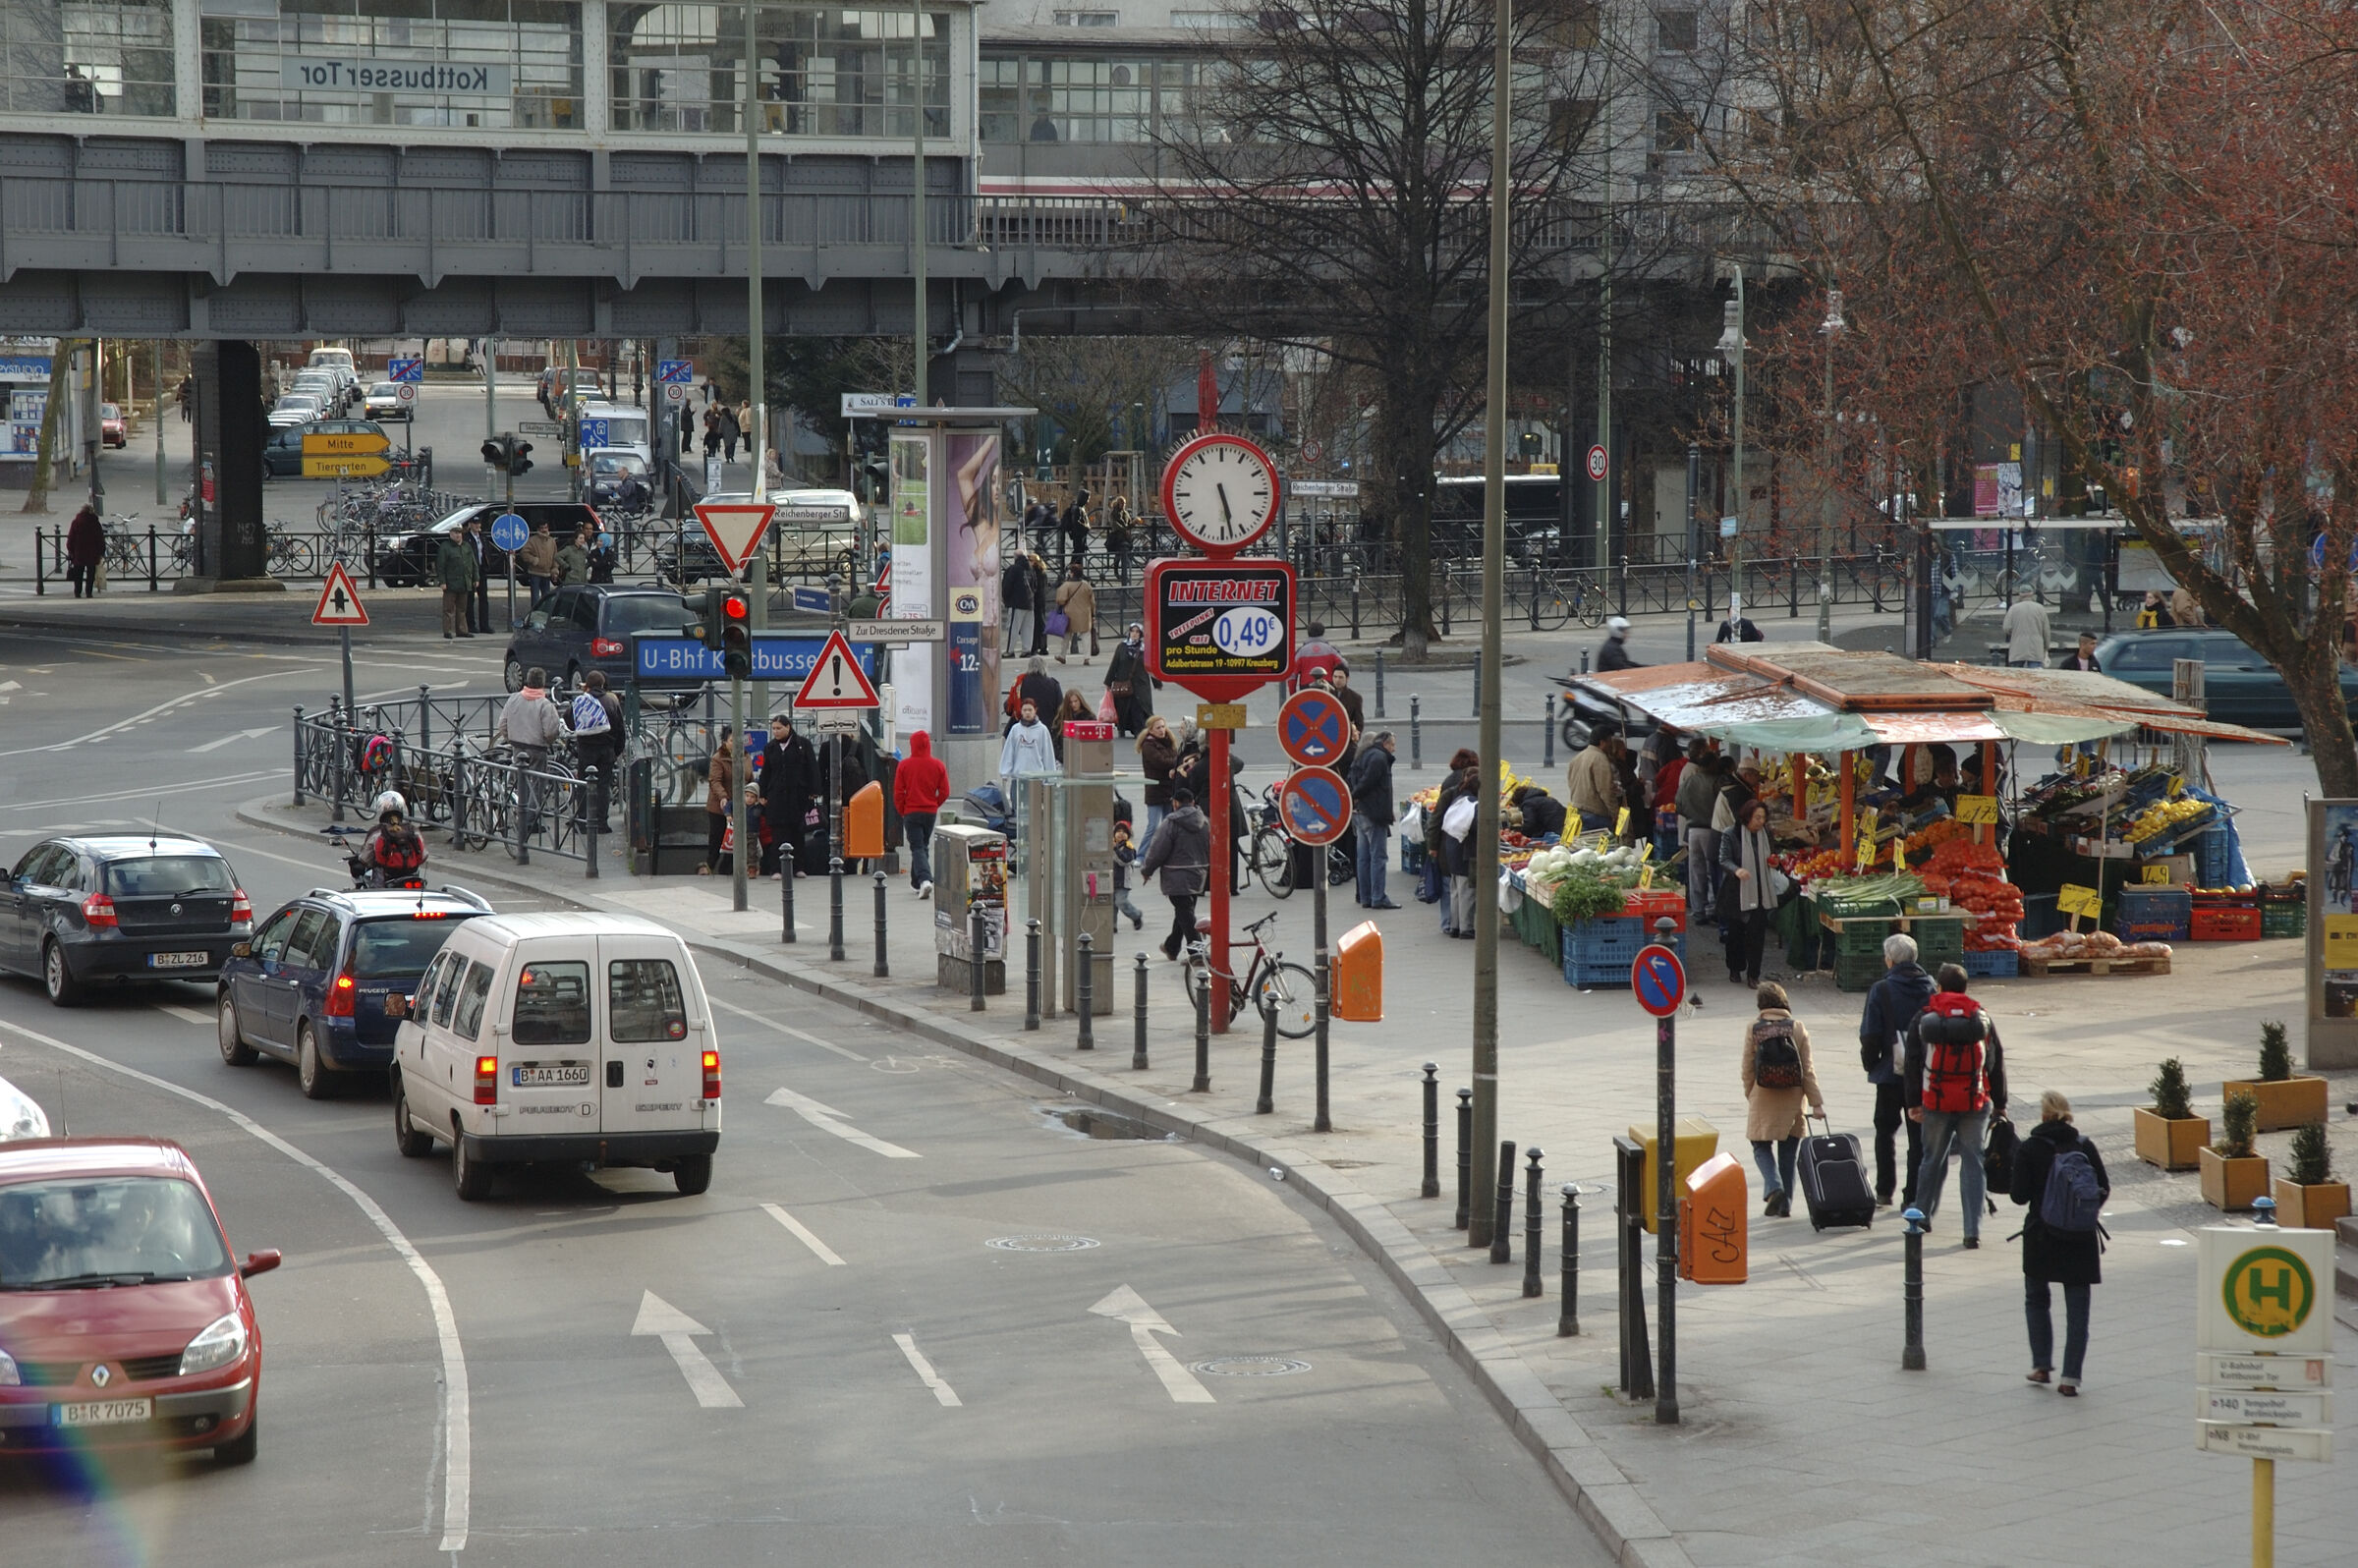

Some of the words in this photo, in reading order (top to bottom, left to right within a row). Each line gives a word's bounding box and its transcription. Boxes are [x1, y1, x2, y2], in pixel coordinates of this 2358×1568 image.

[327, 439, 354, 449] Mitte
[316, 462, 366, 474] Tiergarten
[1592, 455, 1604, 471] 30
[774, 509, 831, 520] Reichenberger
[1168, 579, 1280, 601] INTERNET
[856, 625, 868, 637] Zur
[869, 624, 909, 637] Dresdener
[1165, 645, 1183, 656] pro
[1184, 644, 1218, 655] Stunde
[645, 648, 705, 670] U-Bhf
[712, 648, 817, 670] Ktbusse
[157, 954, 165, 965] B
[171, 953, 184, 964] ZL
[186, 952, 204, 963] 216
[521, 1070, 529, 1082] B
[537, 1069, 553, 1082] AA
[557, 1067, 587, 1082] 1660
[2249, 1267, 2290, 1311] H
[68, 1406, 79, 1421] B
[89, 1405, 100, 1420] R
[104, 1401, 145, 1419] 7075
